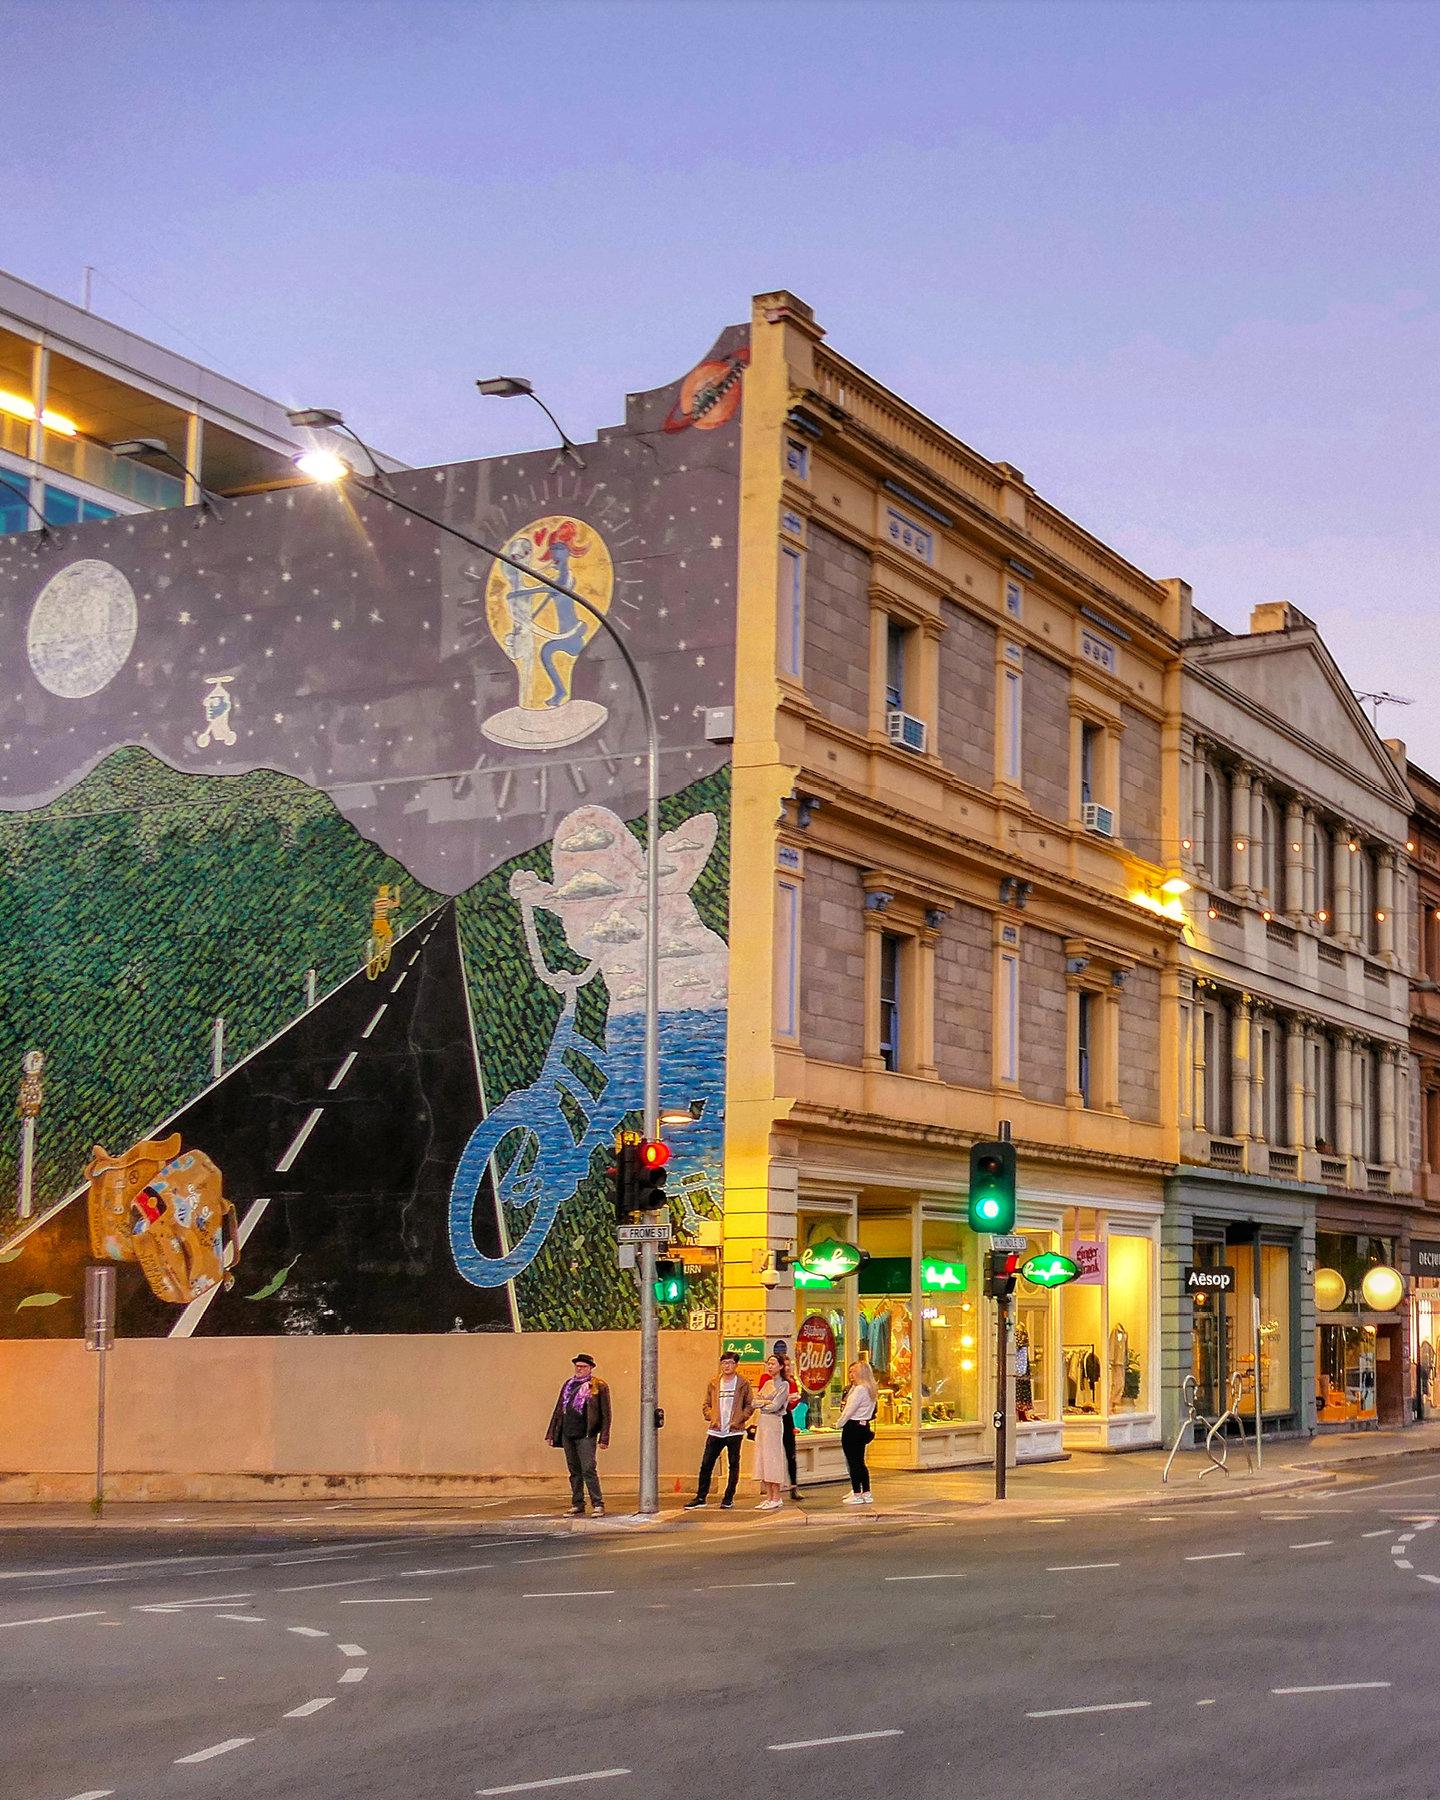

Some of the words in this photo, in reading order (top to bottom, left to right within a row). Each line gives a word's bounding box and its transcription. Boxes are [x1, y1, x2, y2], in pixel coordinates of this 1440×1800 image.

[629, 1228, 656, 1238] FROME
[658, 1228, 667, 1238] ST
[800, 1341, 834, 1371] Sale
